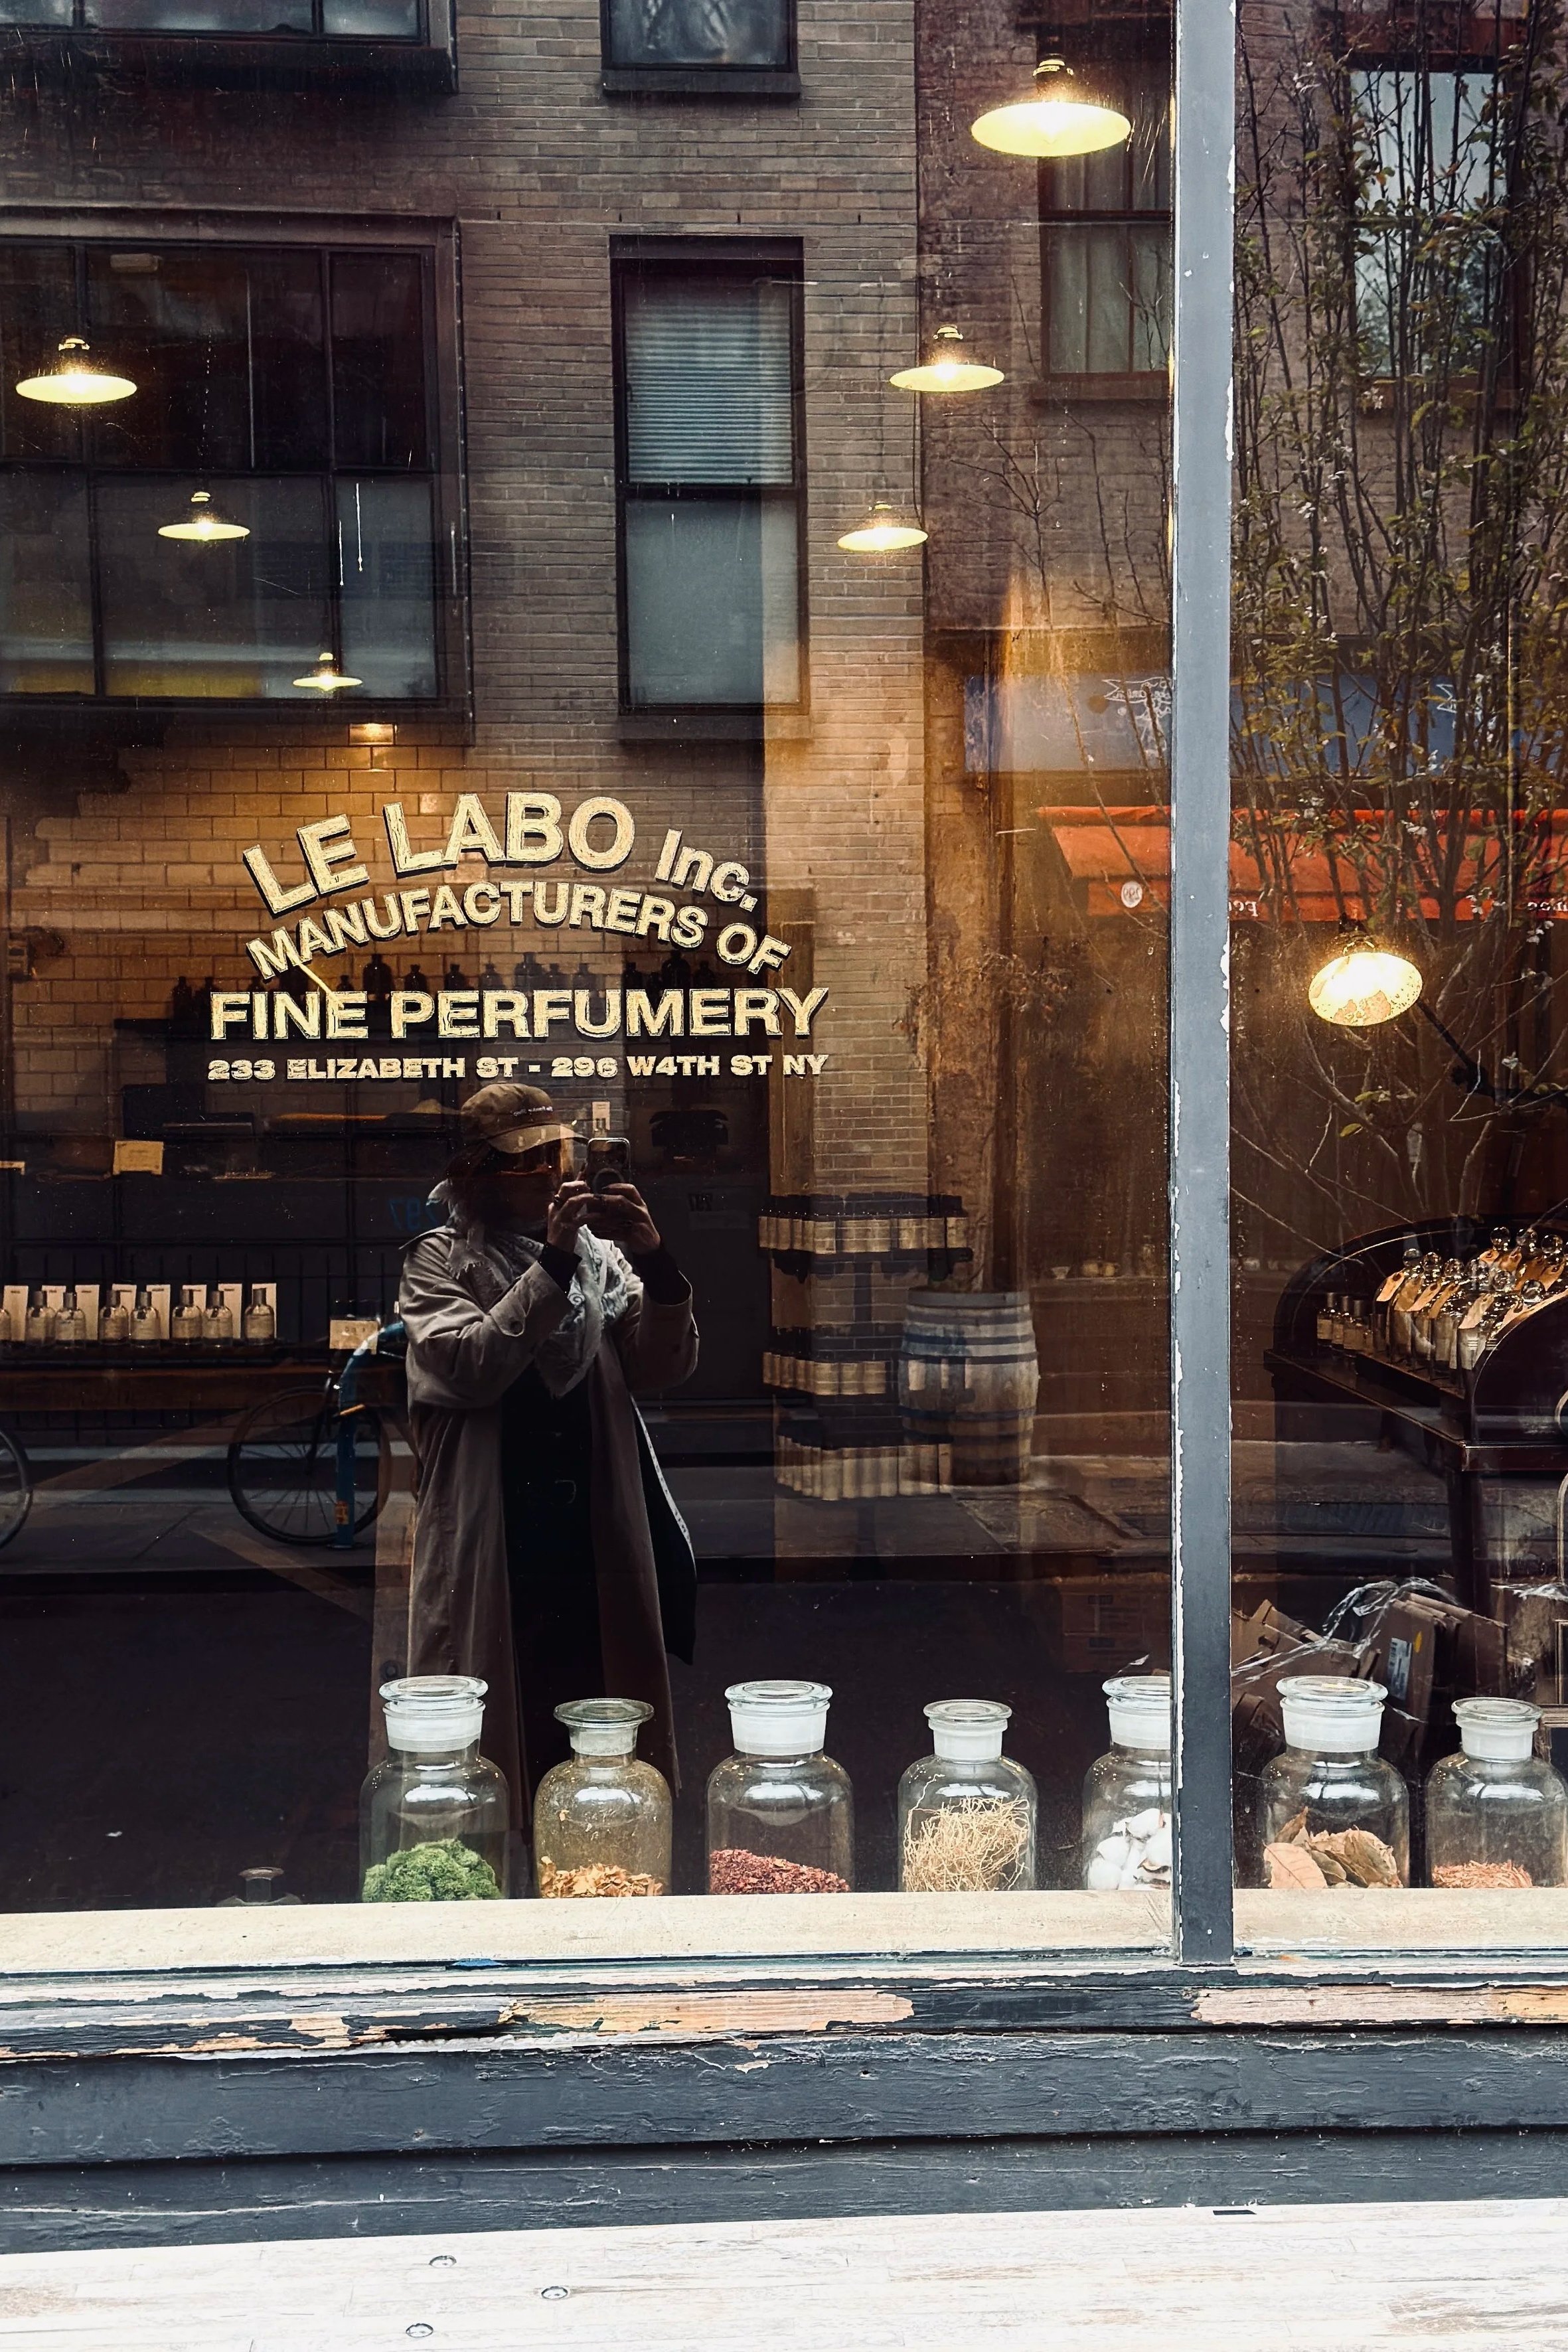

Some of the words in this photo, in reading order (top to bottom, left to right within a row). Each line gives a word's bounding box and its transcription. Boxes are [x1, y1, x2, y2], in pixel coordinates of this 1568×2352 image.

[243, 814, 369, 915] LE
[382, 791, 635, 873] LABO
[655, 828, 757, 911] Inc.
[246, 882, 708, 980] MANUFACTURERS
[716, 922, 791, 975] OF
[210, 990, 369, 1040] FINE
[390, 986, 830, 1039] PERFUMERY
[208, 1059, 276, 1080] 233
[287, 1057, 466, 1079] ELIZABETH
[477, 1057, 518, 1077] ST
[552, 1058, 618, 1077] 296
[627, 1055, 720, 1077] W4TH
[731, 1054, 773, 1075] ST
[783, 1053, 830, 1077] NY
